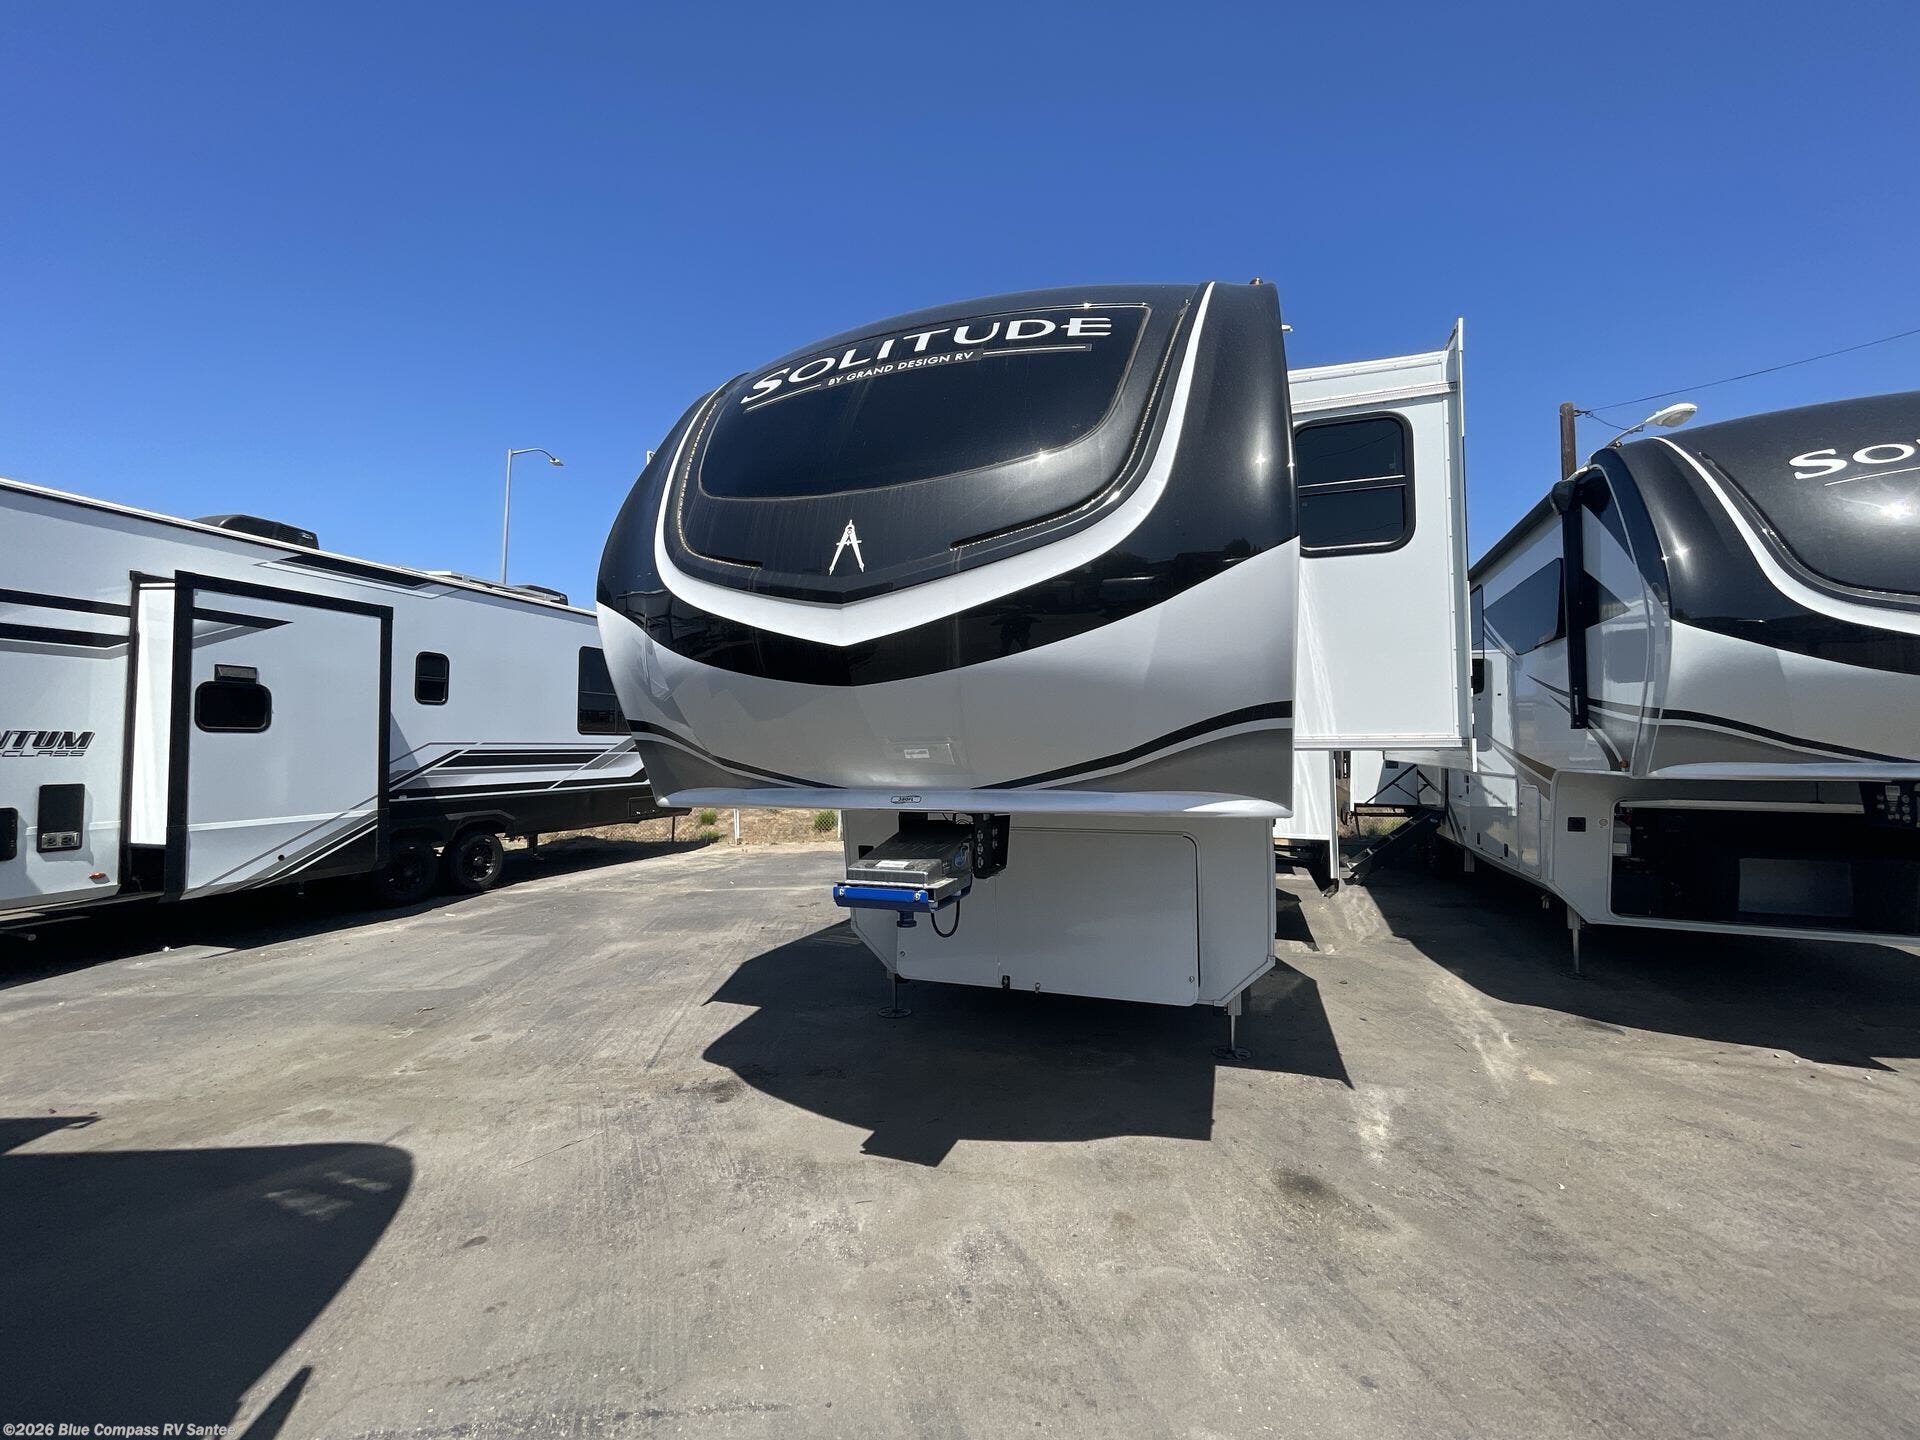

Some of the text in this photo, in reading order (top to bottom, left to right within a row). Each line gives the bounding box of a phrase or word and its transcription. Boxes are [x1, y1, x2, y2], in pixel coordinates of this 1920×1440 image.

[741, 317, 1112, 403] SOLITUDE
[828, 351, 974, 386] BY GRAND DESIGN RV
[1788, 438, 1920, 480] SO
